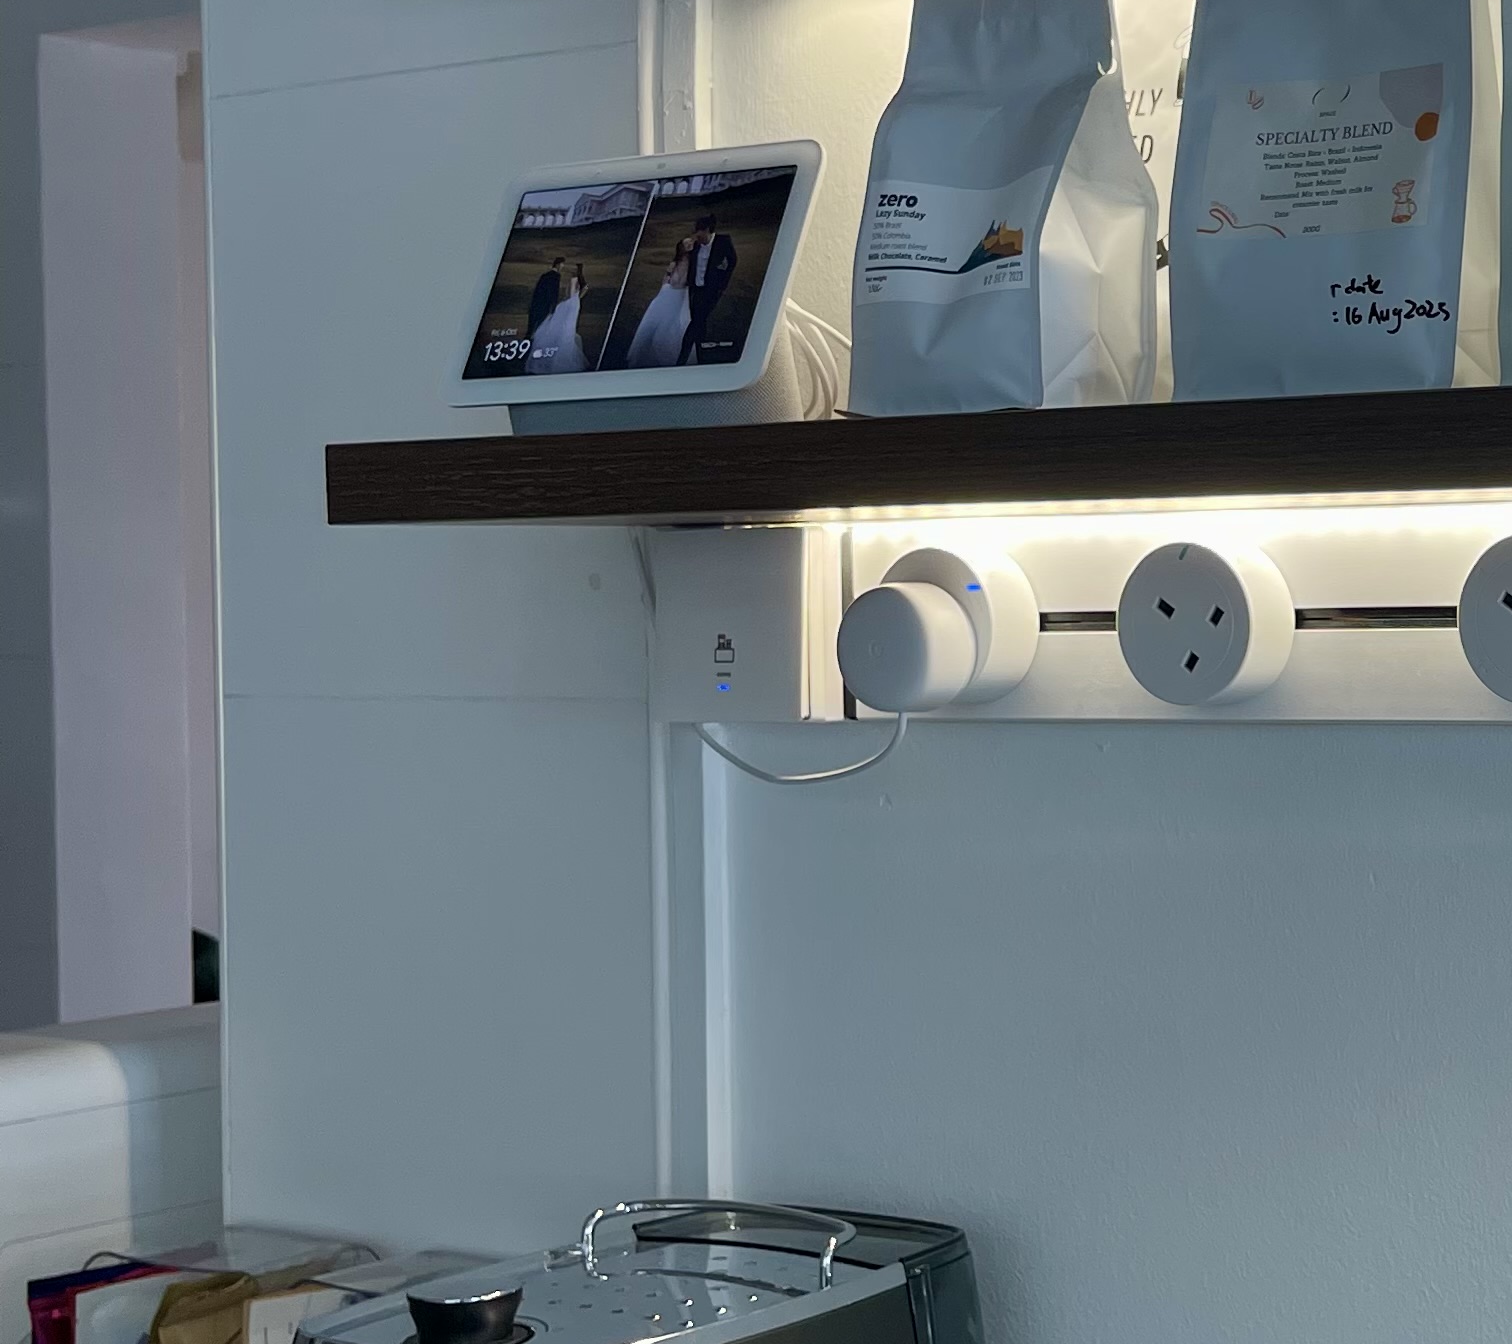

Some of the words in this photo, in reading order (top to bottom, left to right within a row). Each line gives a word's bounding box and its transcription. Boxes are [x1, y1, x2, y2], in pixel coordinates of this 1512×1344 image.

[1256, 127, 1341, 146] SPECIALTY
[1342, 121, 1394, 141] BLEND
[1353, 154, 1379, 163] Almond
[878, 193, 918, 209] zero
[875, 209, 892, 221] Lazy
[893, 209, 927, 221] Sunday
[883, 232, 912, 241] Colombia
[915, 253, 948, 264] Caramel
[1344, 274, 1384, 295] date
[484, 339, 531, 362] 13:39
